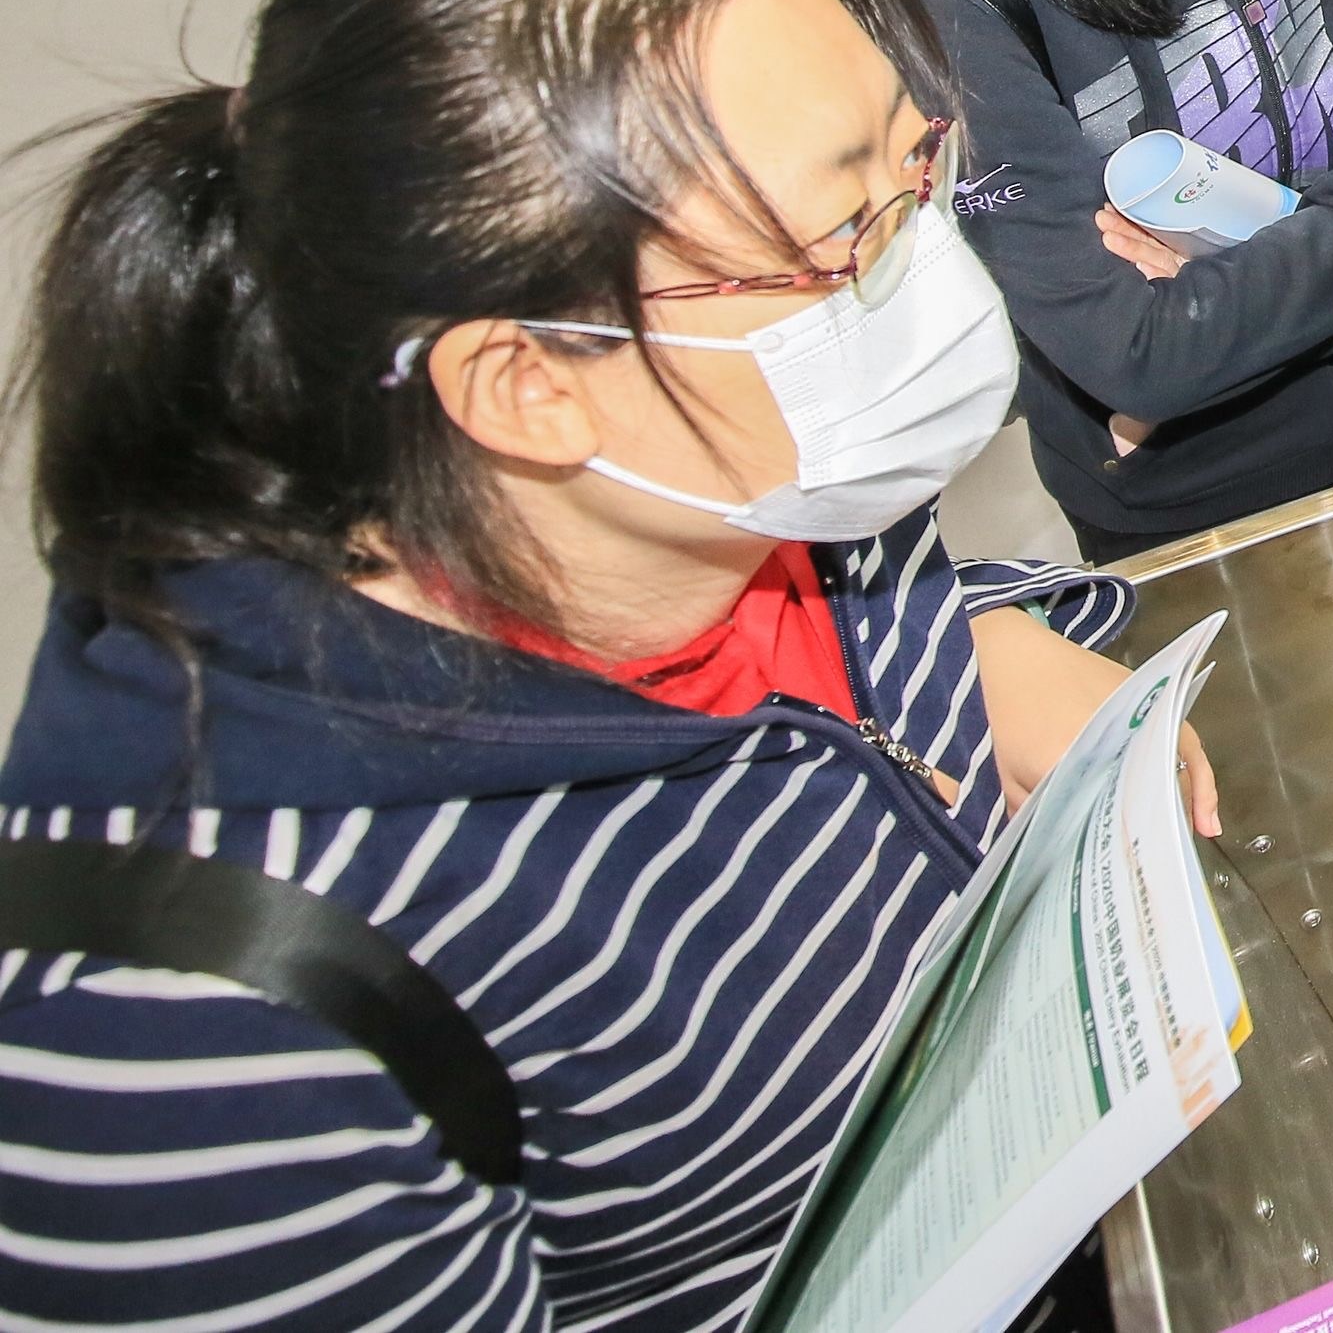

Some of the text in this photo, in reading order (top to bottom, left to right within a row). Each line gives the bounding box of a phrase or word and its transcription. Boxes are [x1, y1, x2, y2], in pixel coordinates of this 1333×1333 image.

[954, 182, 1026, 217] ERKE
[1101, 860, 1150, 1083] 2020中国奶业展览会日程
